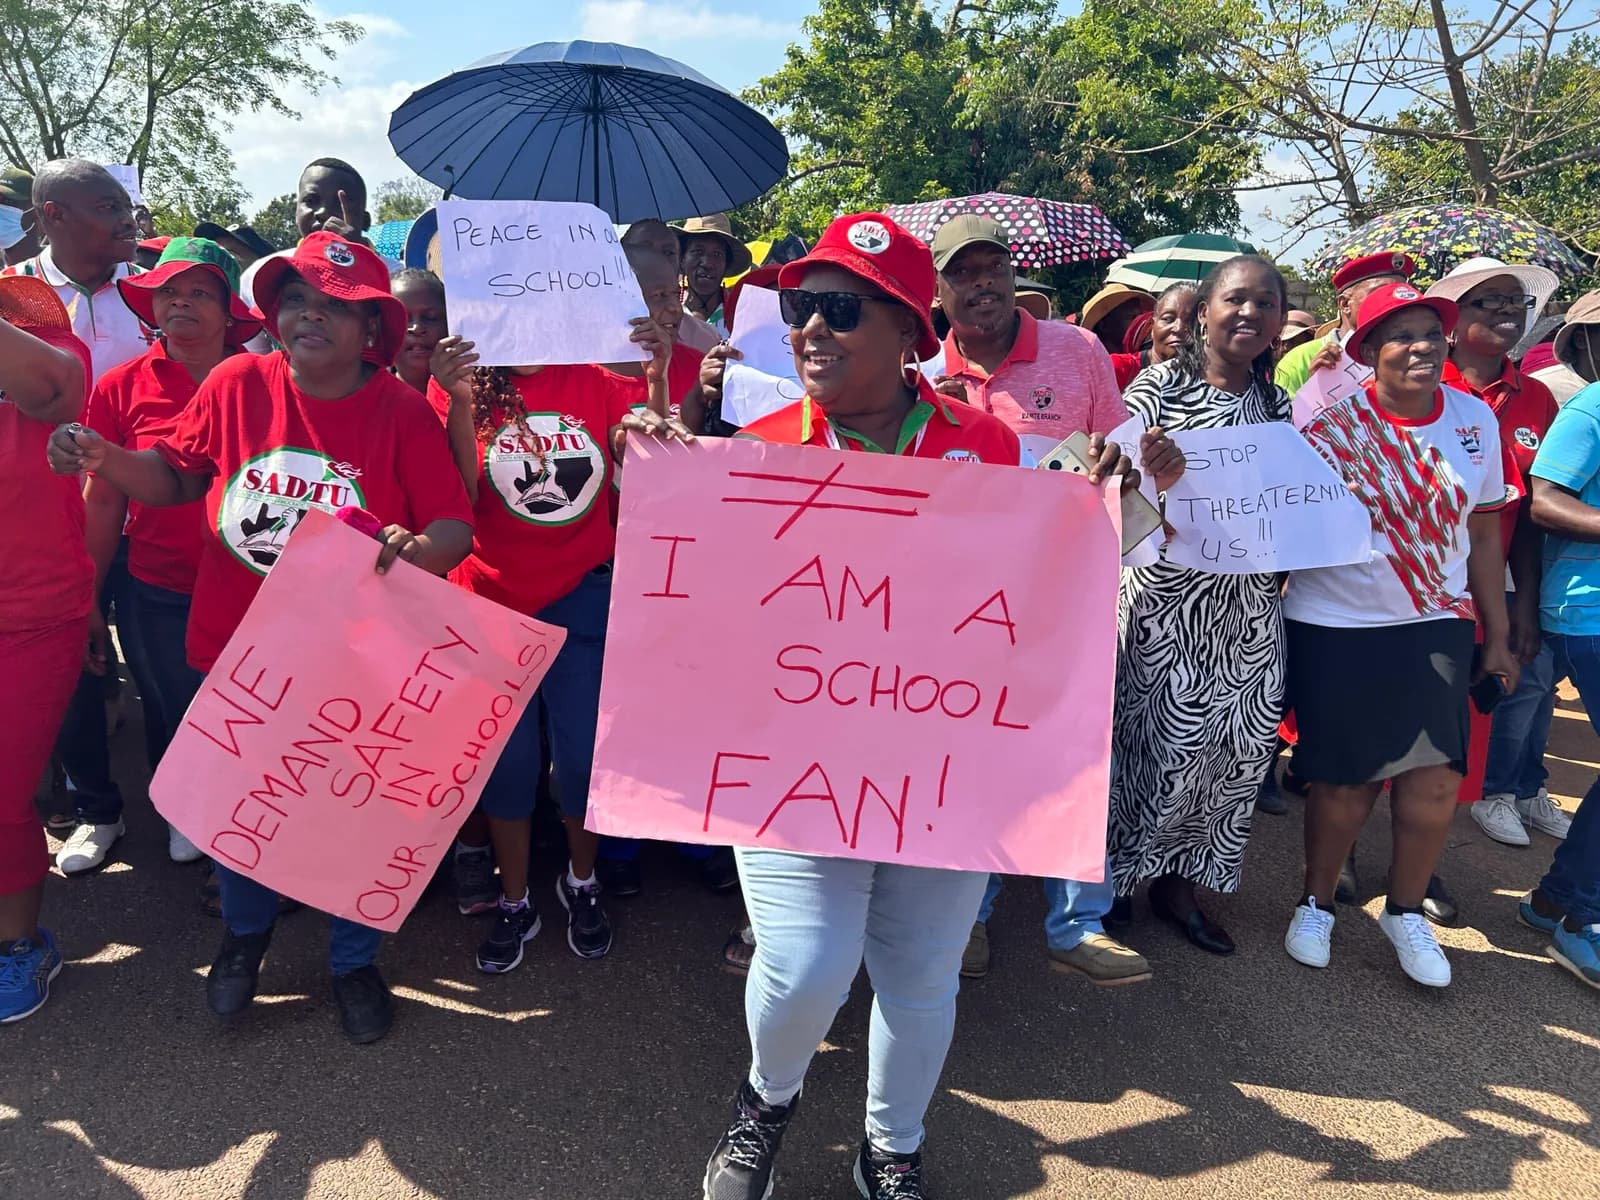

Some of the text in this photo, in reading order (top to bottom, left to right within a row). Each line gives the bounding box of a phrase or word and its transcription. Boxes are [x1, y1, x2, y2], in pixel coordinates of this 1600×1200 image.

[453, 217, 543, 252] PEACE
[568, 223, 597, 243] IN
[242, 468, 351, 508] SADTU
[500, 432, 585, 455] SADTU
[1182, 445, 1258, 471] STOP
[642, 535, 1017, 647] I AM A
[187, 645, 294, 759] WE
[330, 624, 480, 809] SAFETY
[773, 644, 1031, 731] SCHOOL
[210, 697, 363, 871] DEMAND
[355, 621, 556, 922] OUR SCHOOLS!
[380, 762, 436, 808] IN
[703, 751, 951, 854] FAN!
